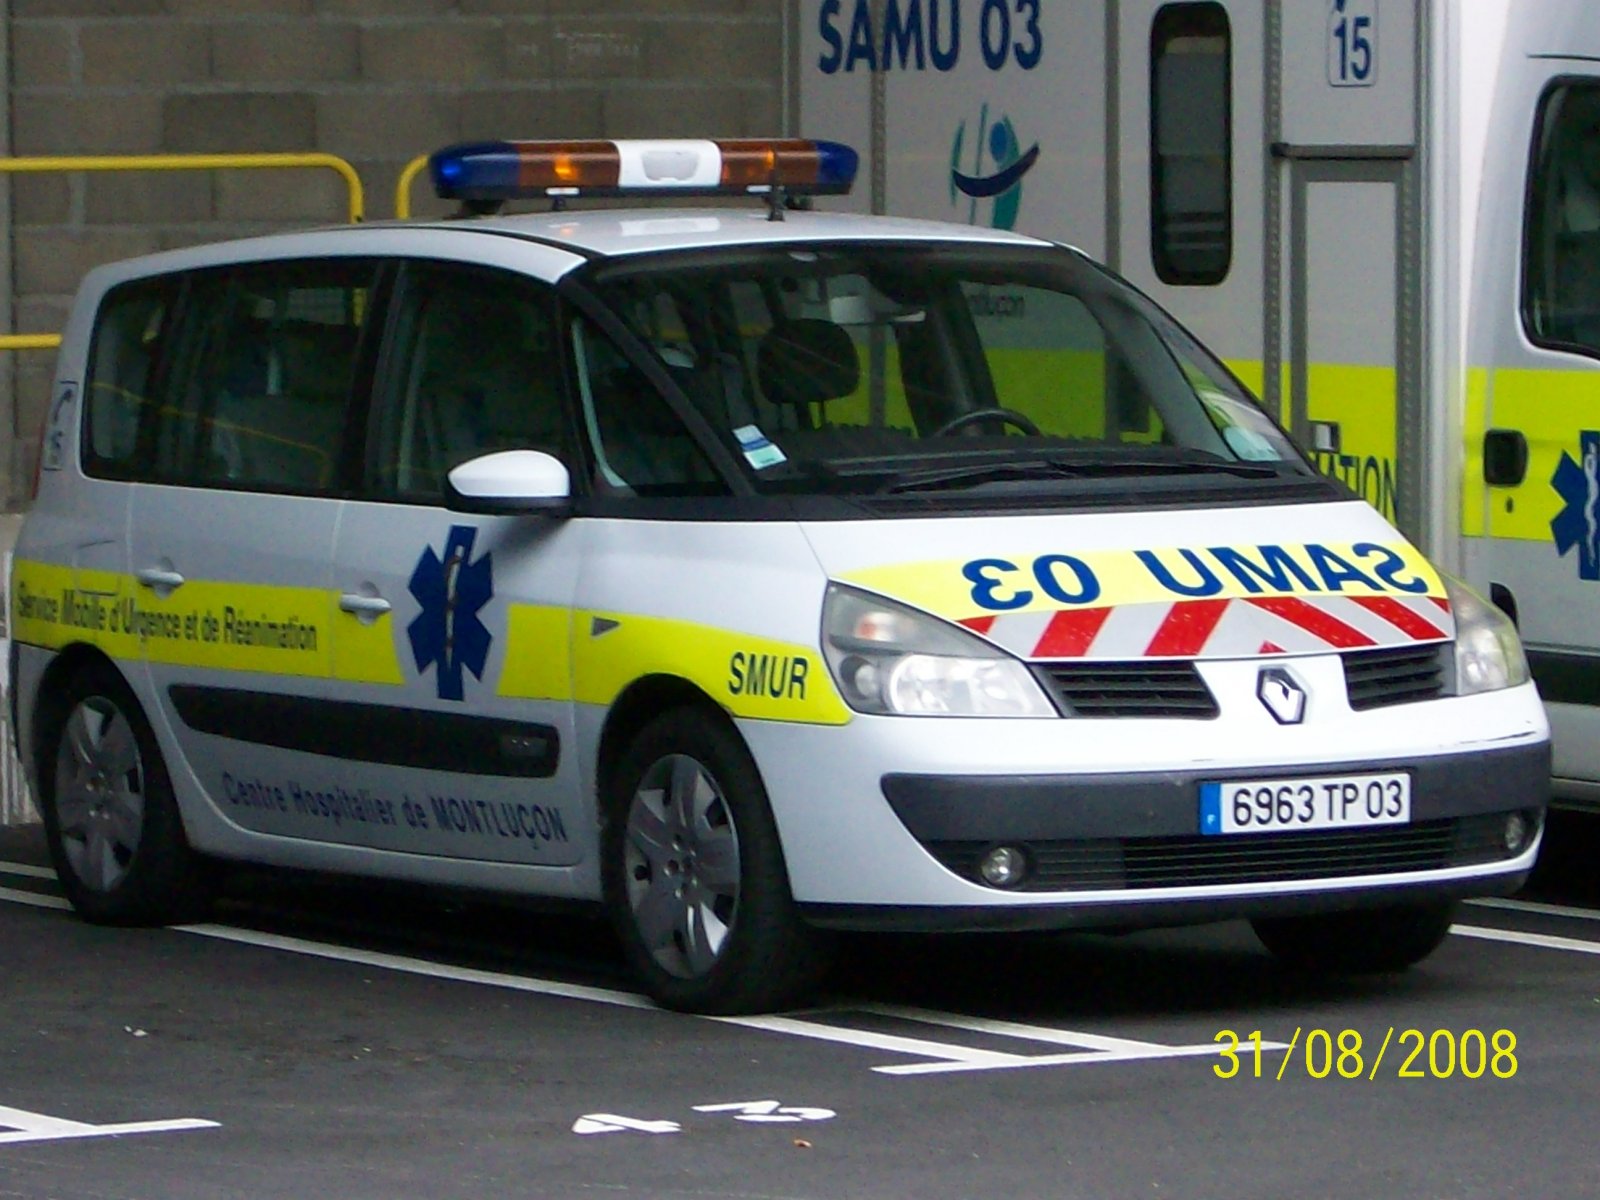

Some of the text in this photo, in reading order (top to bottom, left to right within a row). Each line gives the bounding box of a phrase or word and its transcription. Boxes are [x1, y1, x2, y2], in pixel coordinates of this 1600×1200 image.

[818, 0, 1043, 74] SAMU 03
[1333, 16, 1372, 80] 15
[18, 580, 58, 623] Service
[62, 588, 107, 631] Mobile
[185, 609, 198, 642] et
[203, 609, 219, 642] de
[223, 605, 317, 652] Réanimation
[727, 651, 808, 700] SMUR
[222, 771, 568, 850] Centre Hospitalier de MONTLUÇON
[1206, 813, 1217, 826] F
[1233, 779, 1403, 826] 6963 TP 03
